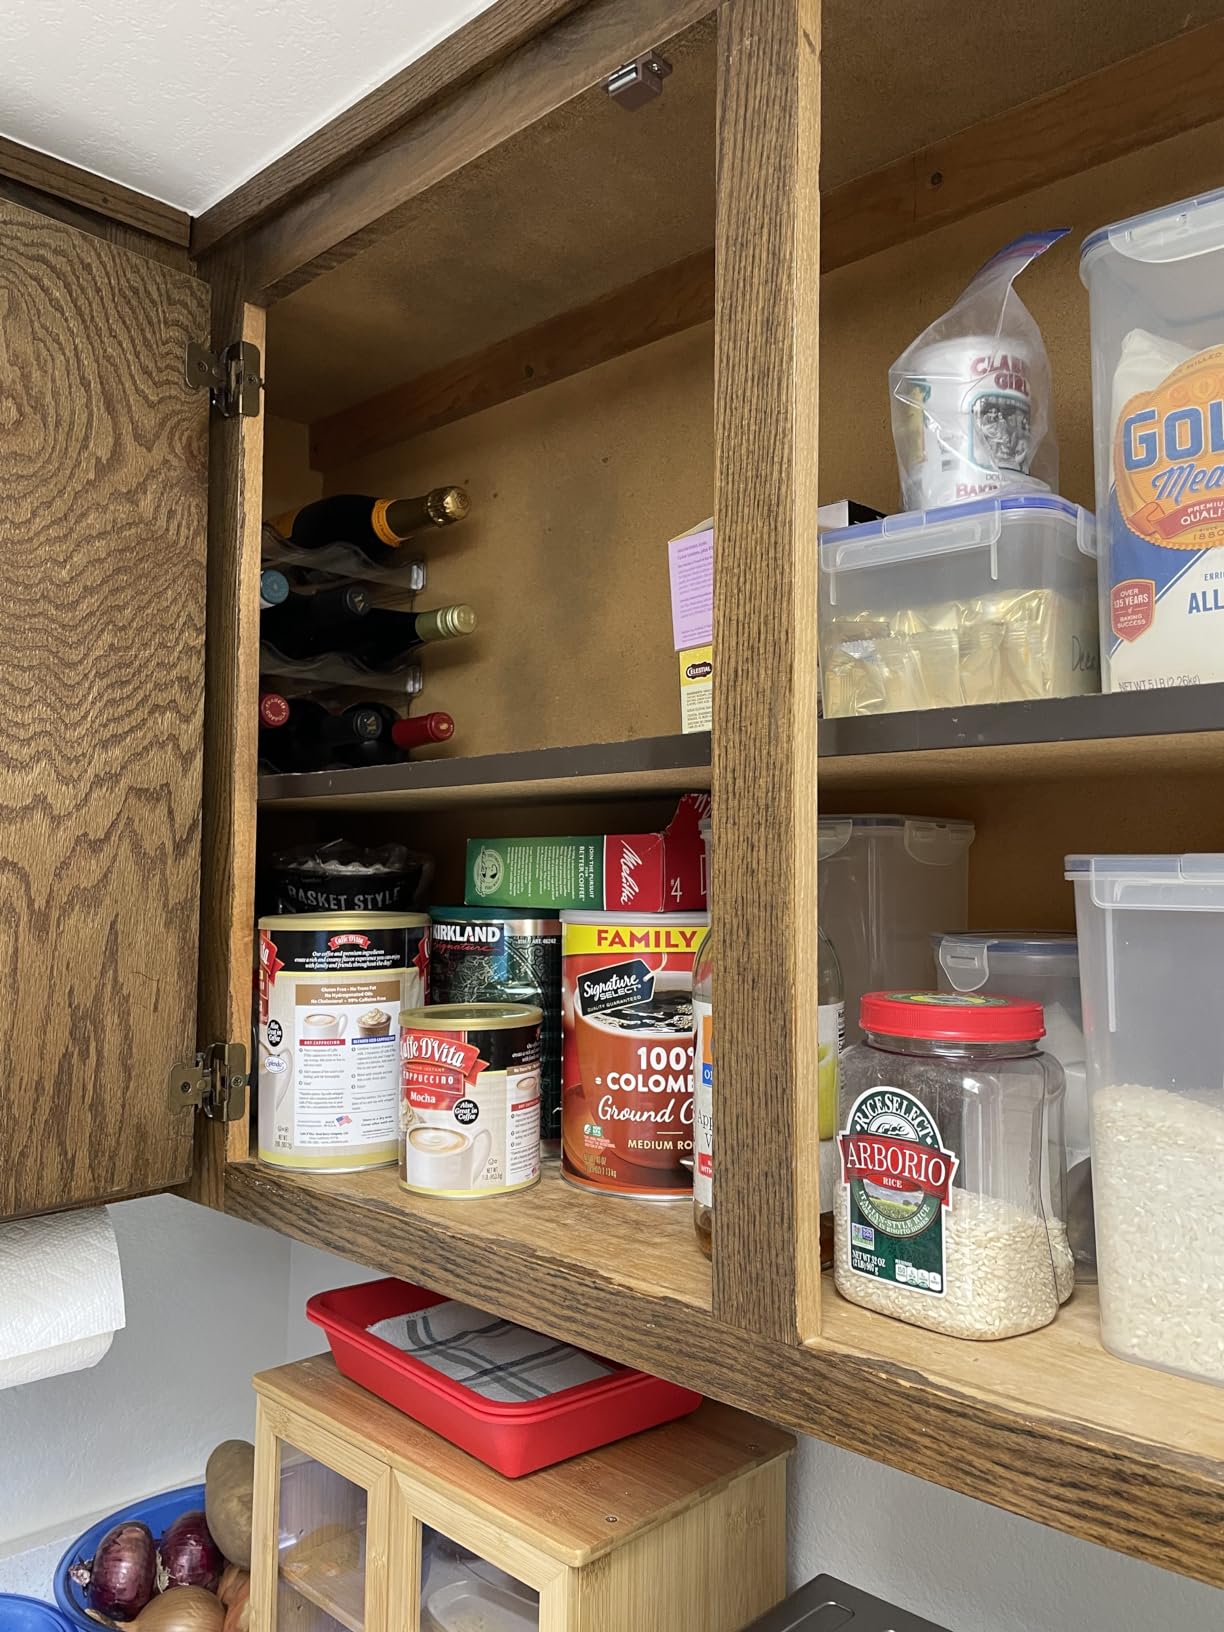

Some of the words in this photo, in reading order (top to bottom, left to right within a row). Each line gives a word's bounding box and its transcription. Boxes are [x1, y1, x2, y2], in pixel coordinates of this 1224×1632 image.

[1180, 508, 1224, 525] QUALI
[1120, 588, 1139, 596] OVER
[1125, 594, 1149, 606] YEARS
[1117, 619, 1146, 628] SUCCESS
[1120, 614, 1143, 622] BAKING
[621, 839, 642, 905] Melitta
[287, 885, 347, 910] BASKET
[432, 924, 500, 942] KIRKLAND
[597, 929, 697, 948] FAMILY
[584, 974, 639, 1001] Signature
[600, 985, 638, 1001] SELECT
[587, 1003, 605, 1013] QUALITY
[606, 995, 642, 1008] GUARANTEED
[420, 1037, 465, 1068] D'Vita
[410, 1091, 436, 1104] Mocha
[457, 1113, 476, 1121] Coffee
[598, 1095, 675, 1123] Ground
[628, 1139, 673, 1150] MEDIUM
[847, 1141, 946, 1186] ARBORIO
[882, 1177, 903, 1188] RICE
[913, 1204, 930, 1224] RICE
[852, 1250, 862, 1260] NET
[862, 1253, 871, 1262] WT
[877, 1257, 886, 1267] OZ
